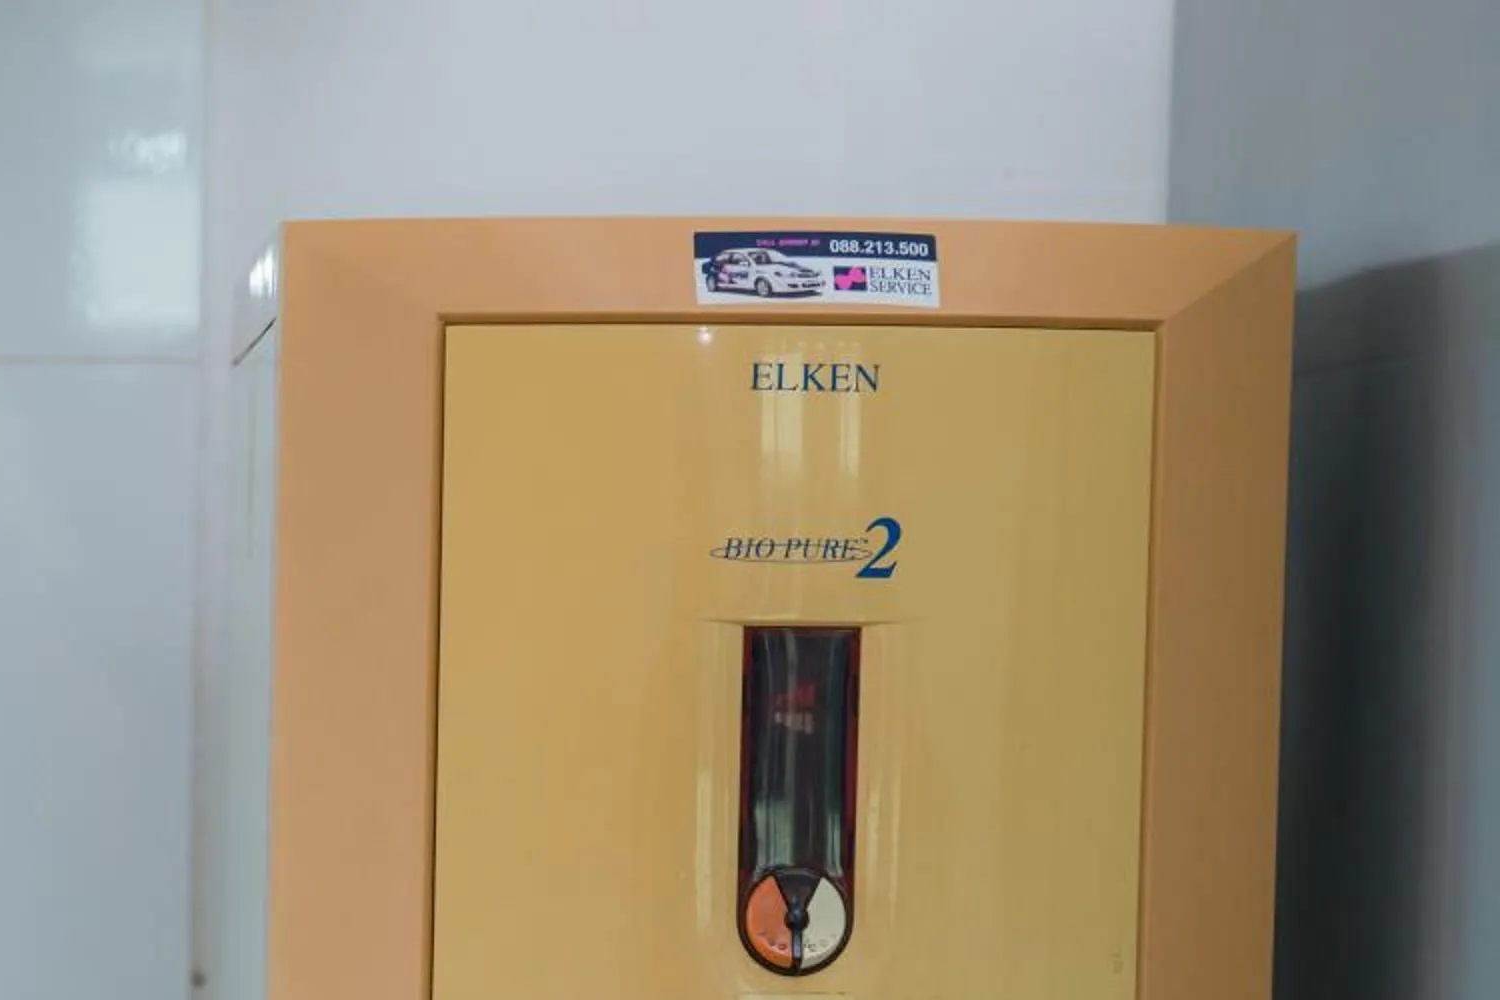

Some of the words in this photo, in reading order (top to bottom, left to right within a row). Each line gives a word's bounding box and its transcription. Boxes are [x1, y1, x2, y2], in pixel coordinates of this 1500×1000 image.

[829, 239, 929, 256] 088.213.500
[869, 266, 931, 281] ELKEN
[869, 281, 932, 295] SERVICE
[751, 362, 880, 392] ELKEN
[724, 537, 775, 560] BIO
[784, 537, 858, 560] PURE
[855, 517, 902, 578] 2
